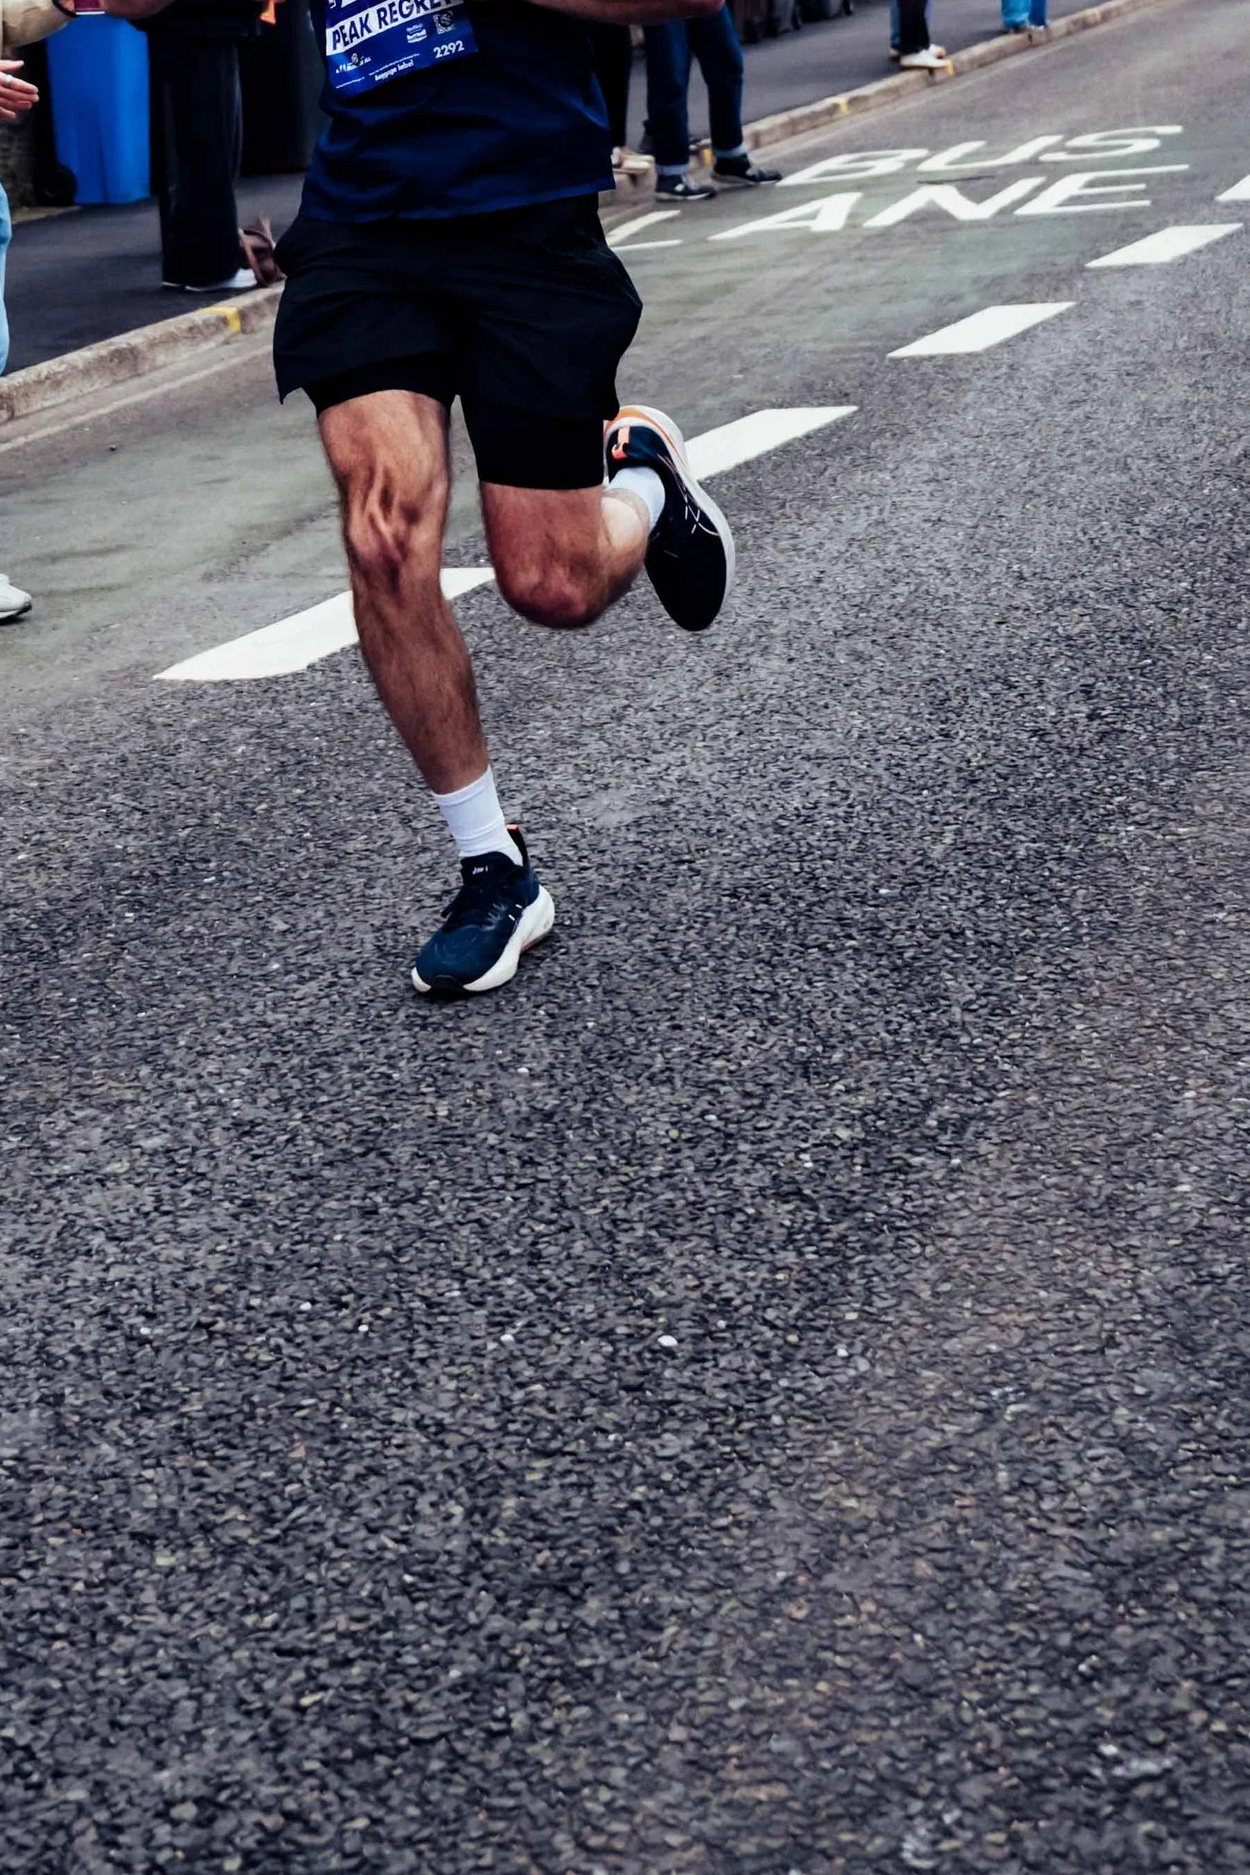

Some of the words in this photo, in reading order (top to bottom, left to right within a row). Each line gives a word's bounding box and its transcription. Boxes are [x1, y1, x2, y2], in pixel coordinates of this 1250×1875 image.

[332, 12, 373, 51] PEAK
[433, 40, 465, 59] 2292
[775, 125, 1184, 188] BUS
[604, 163, 1190, 252] LANE
